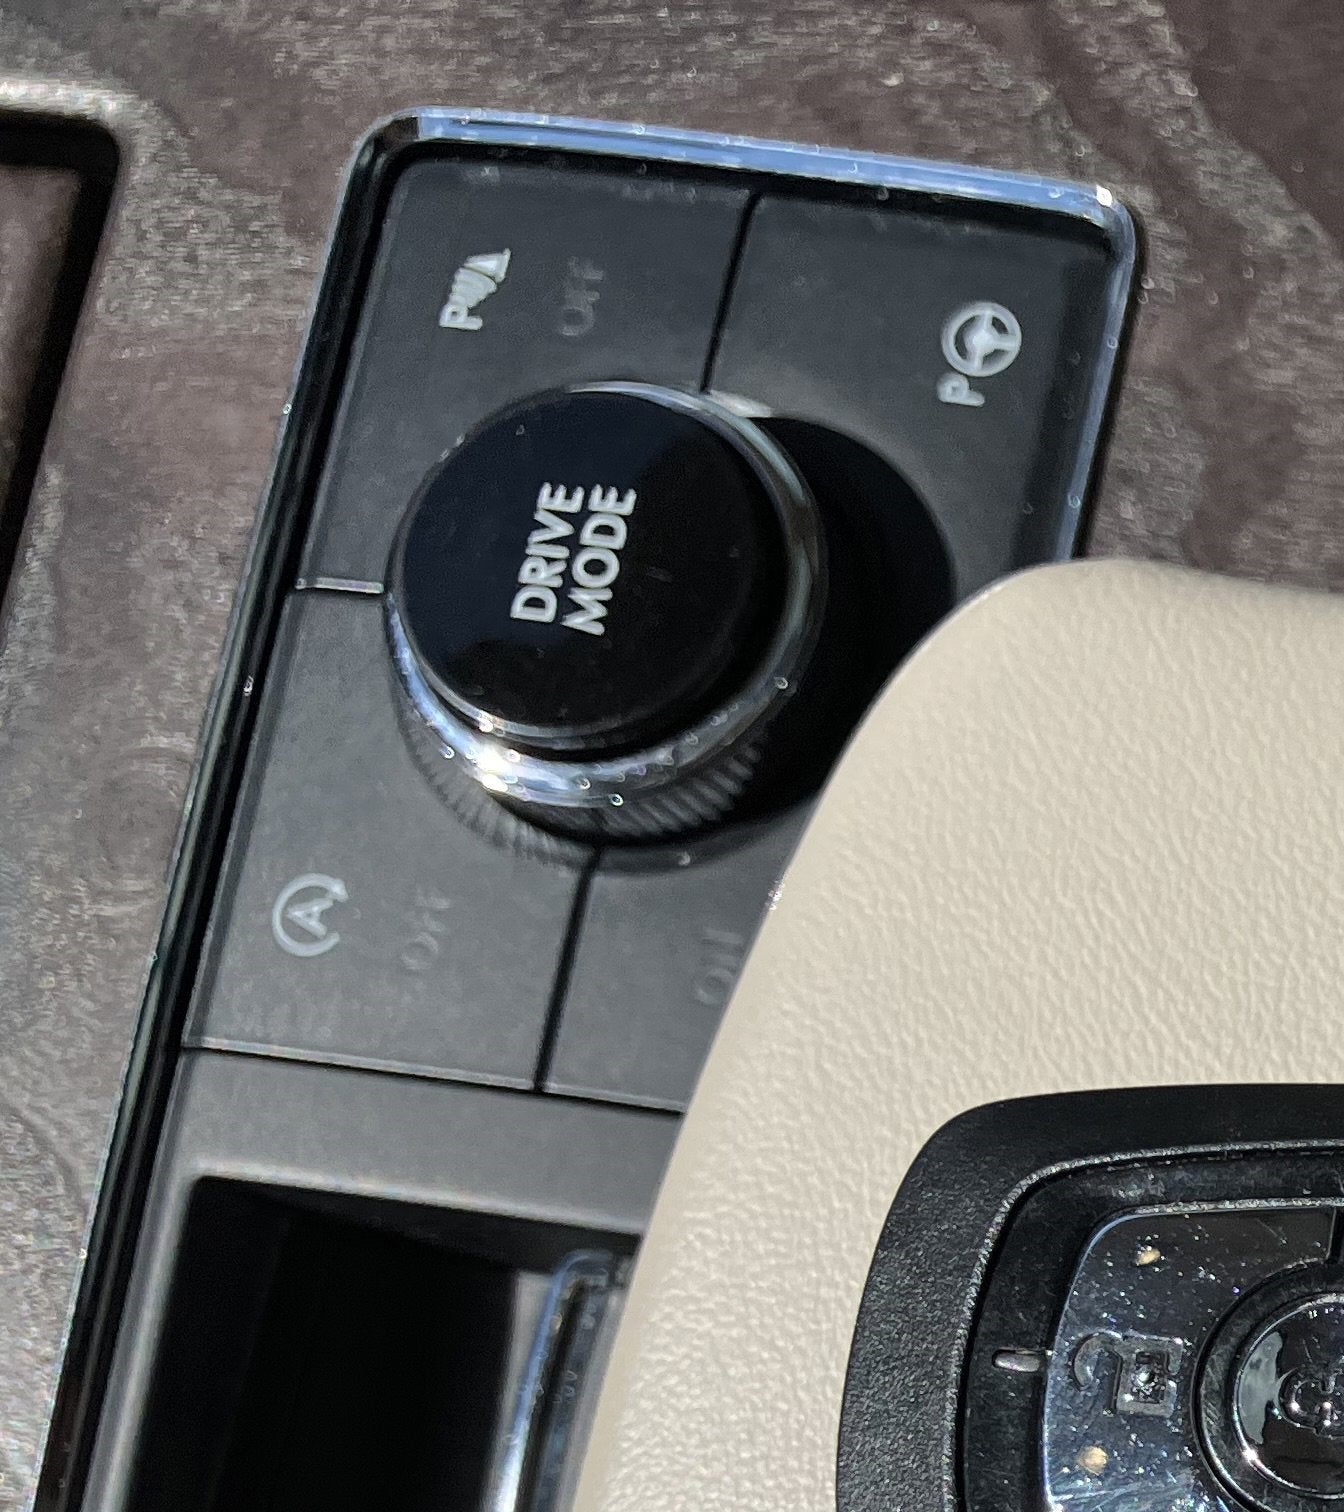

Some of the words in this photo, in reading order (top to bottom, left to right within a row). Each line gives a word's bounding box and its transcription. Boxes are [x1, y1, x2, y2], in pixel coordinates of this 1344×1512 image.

[557, 256, 605, 338] OFF
[509, 481, 585, 624] DRIVE
[559, 483, 638, 637] MODE
